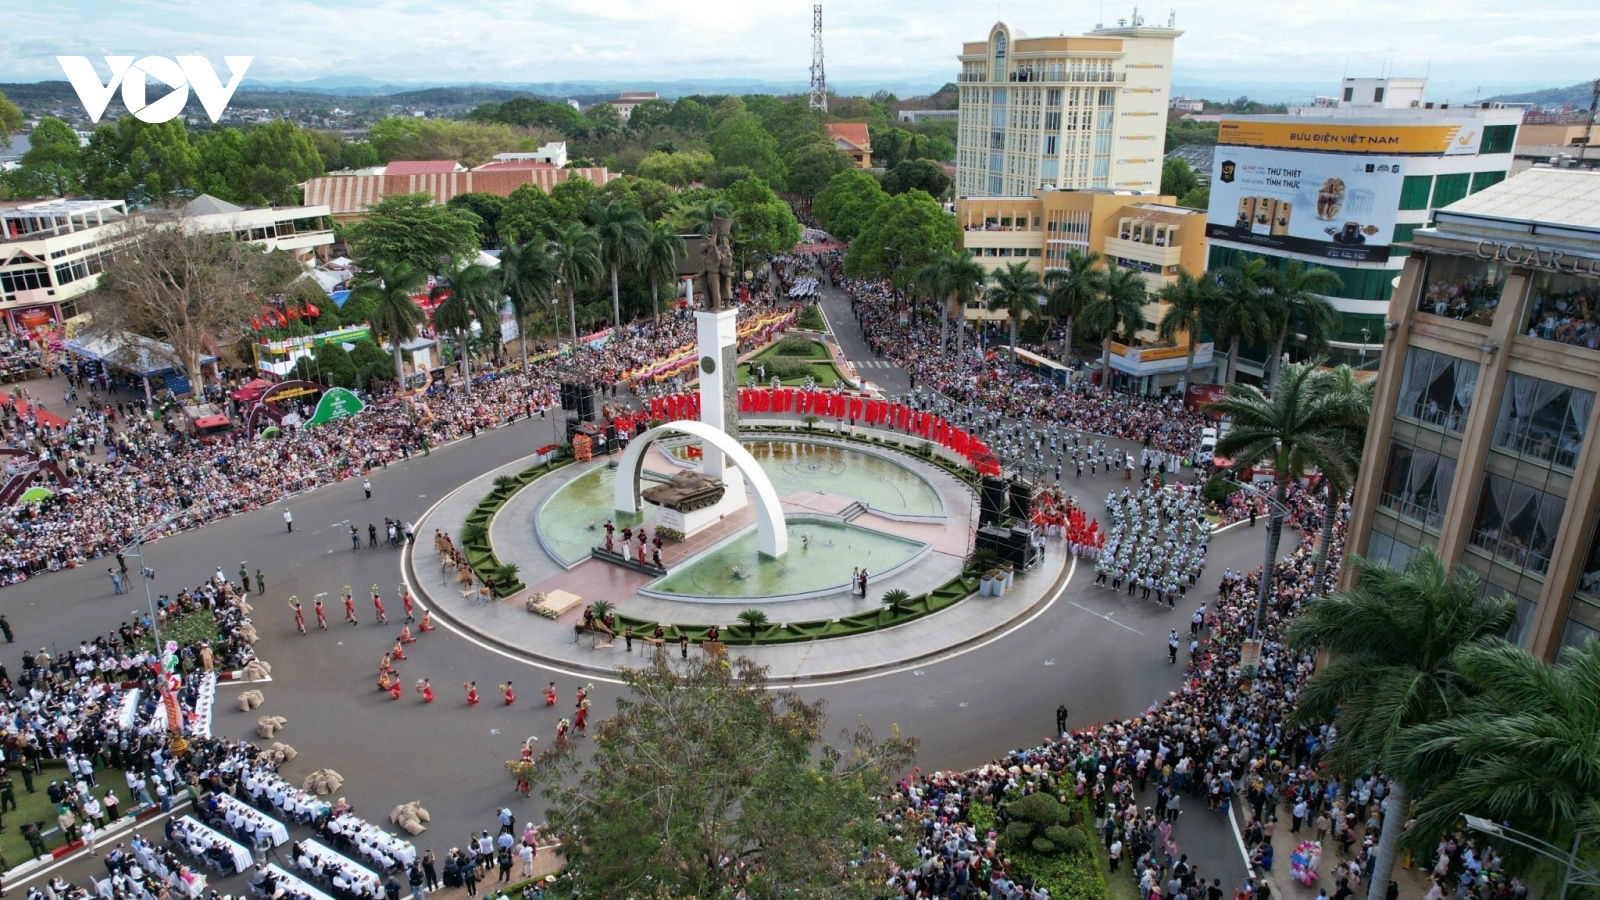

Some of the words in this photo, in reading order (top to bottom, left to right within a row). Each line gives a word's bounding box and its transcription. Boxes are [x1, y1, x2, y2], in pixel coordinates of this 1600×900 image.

[1289, 132, 1311, 141] BƯU
[1313, 132, 1339, 144] ĐIỆN
[1341, 133, 1366, 145] VIỆT
[1368, 136, 1399, 144] NAM
[1476, 238, 1565, 271] CIGAR
